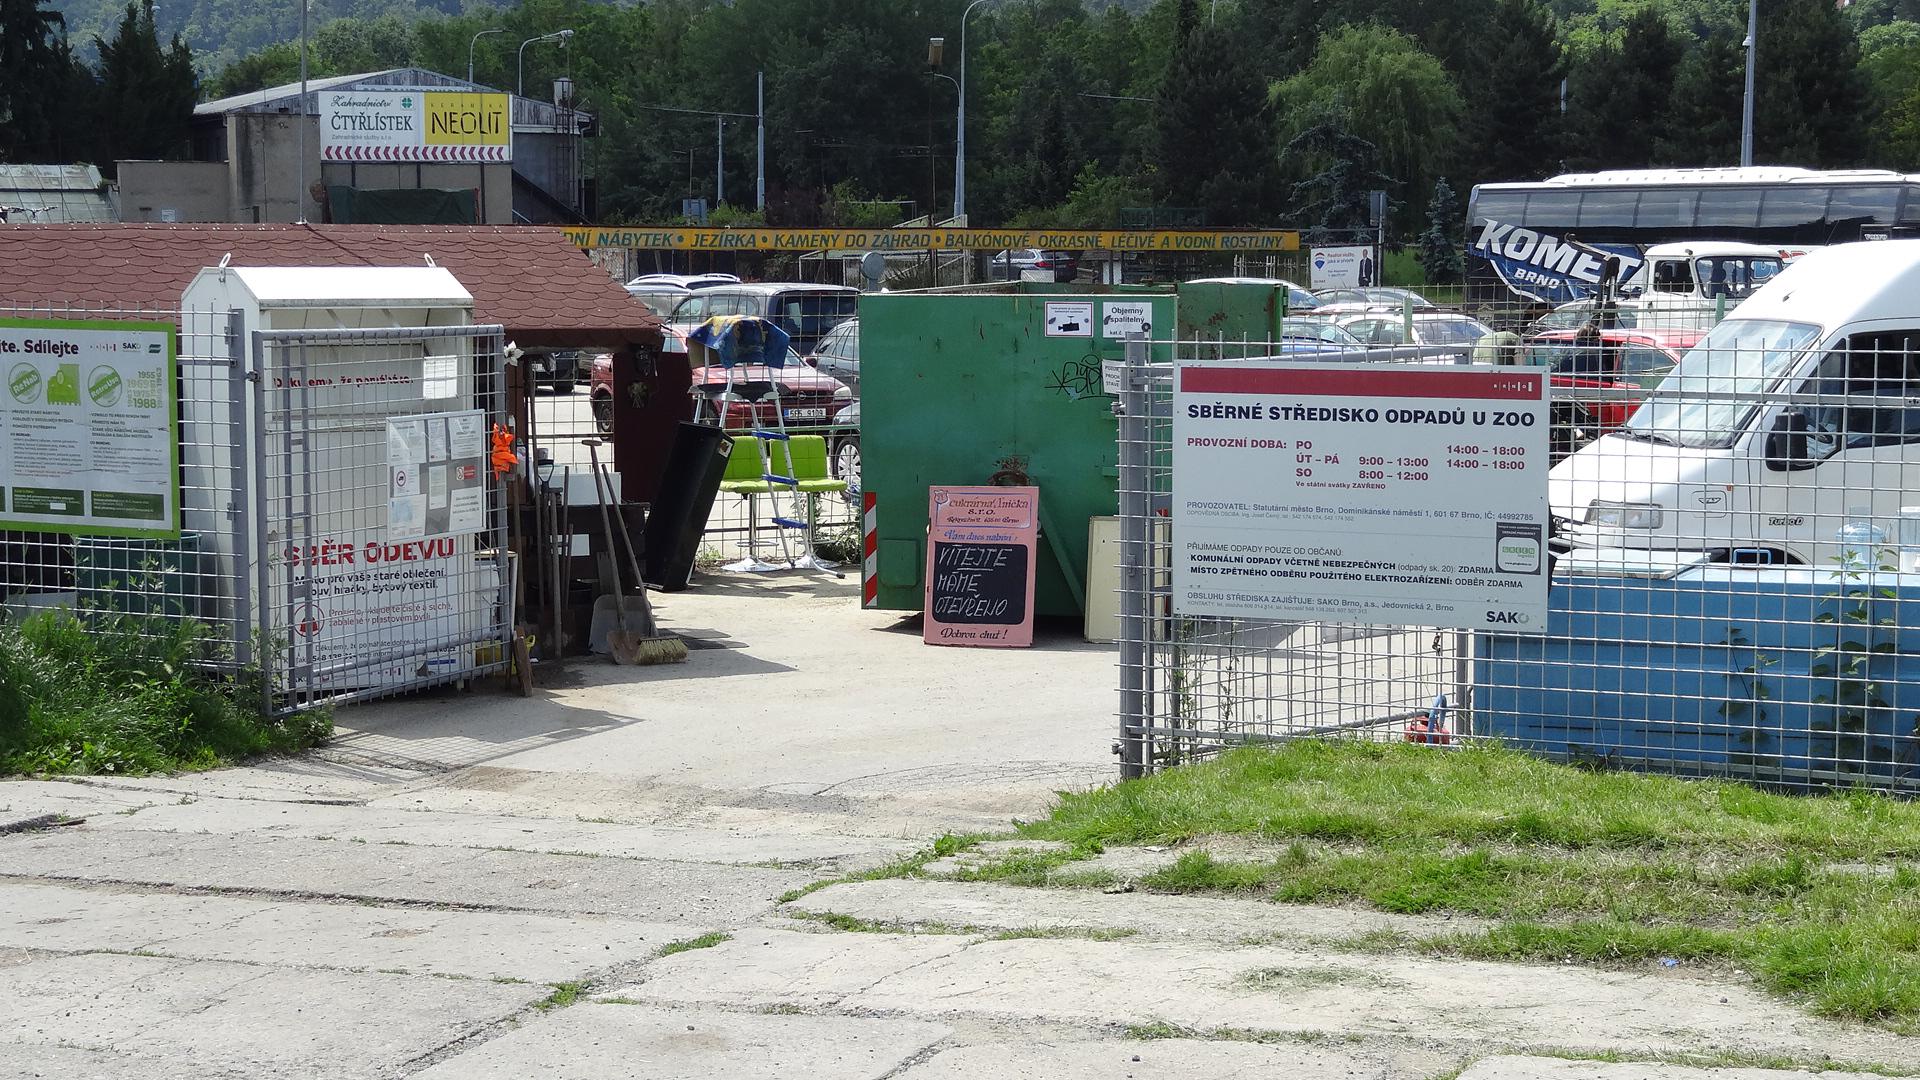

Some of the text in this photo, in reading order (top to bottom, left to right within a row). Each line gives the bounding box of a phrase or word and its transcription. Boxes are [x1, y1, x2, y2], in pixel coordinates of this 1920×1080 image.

[331, 111, 414, 131] ČTYŘLÍSTEK
[431, 112, 502, 135] NEOLIT
[598, 230, 672, 247] NÁBYTEK
[690, 231, 756, 248] JEZÍRKA
[774, 234, 840, 248] KAMENY
[844, 234, 866, 248] DO
[872, 234, 930, 248] ZAHRAD
[1111, 233, 1155, 249] LÉČIVÉ
[1160, 236, 1170, 248] A
[1176, 233, 1216, 249] VODNÍ
[1514, 268, 1560, 289] BRNO
[1112, 307, 1144, 316] Objemný
[24, 340, 79, 358] Sdílejte
[133, 398, 156, 408] 1988
[1188, 402, 1535, 426] SBĚRNÉ STŘEDISKO ODPADŮ U ZOO
[1188, 438, 1524, 456] PROVOZNÍ DOBA: PO 14:00 18:00
[1296, 453, 1524, 470] ÚT PÁ 9:00 13:00 14:00 18:00
[1296, 468, 1428, 481] SO 8:00 12:00
[1328, 482, 1350, 490] svátky
[1186, 502, 1250, 510] PROVOZOVATEL:
[1252, 504, 1288, 512] Statutární
[1316, 506, 1336, 514] Brno,
[1338, 506, 1390, 516] Dominikánské
[1392, 509, 1422, 518] náměstí
[1484, 510, 1495, 520] IČ:
[939, 544, 1012, 567] VÍTEJTE
[1186, 542, 1228, 552] PŘIJÍMÁME
[1264, 546, 1292, 554] POUZE
[1308, 546, 1344, 556] OBČANŮ:
[1190, 554, 1244, 564] KOMUNÁLNÍ
[1246, 556, 1282, 565] ODPADY
[1285, 557, 1320, 567] VČETNĚ
[1322, 560, 1396, 570] NEBEZPEČNÝCH
[1398, 563, 1427, 572] (odpady
[1458, 566, 1494, 574] ZDARMA
[937, 572, 982, 593] MÁME
[1190, 566, 1523, 588] MÍSTO ZPĚTNÉHO ODBĚRU POUŽITÉHO ELEKTROZAŘÍZENÍ: ODBĚR ZDARMA
[936, 594, 1008, 617] OTEVŘENO
[1188, 592, 1224, 600] OBSLUHU
[1226, 593, 1270, 602] STŘEDISKA
[1271, 595, 1314, 604] ZAJIŠŤUJE:
[1342, 600, 1362, 608] Brno,
[1382, 601, 1424, 610] Jedovnická
[1486, 610, 1530, 624] SAKO
[940, 628, 976, 640] Dobrou
